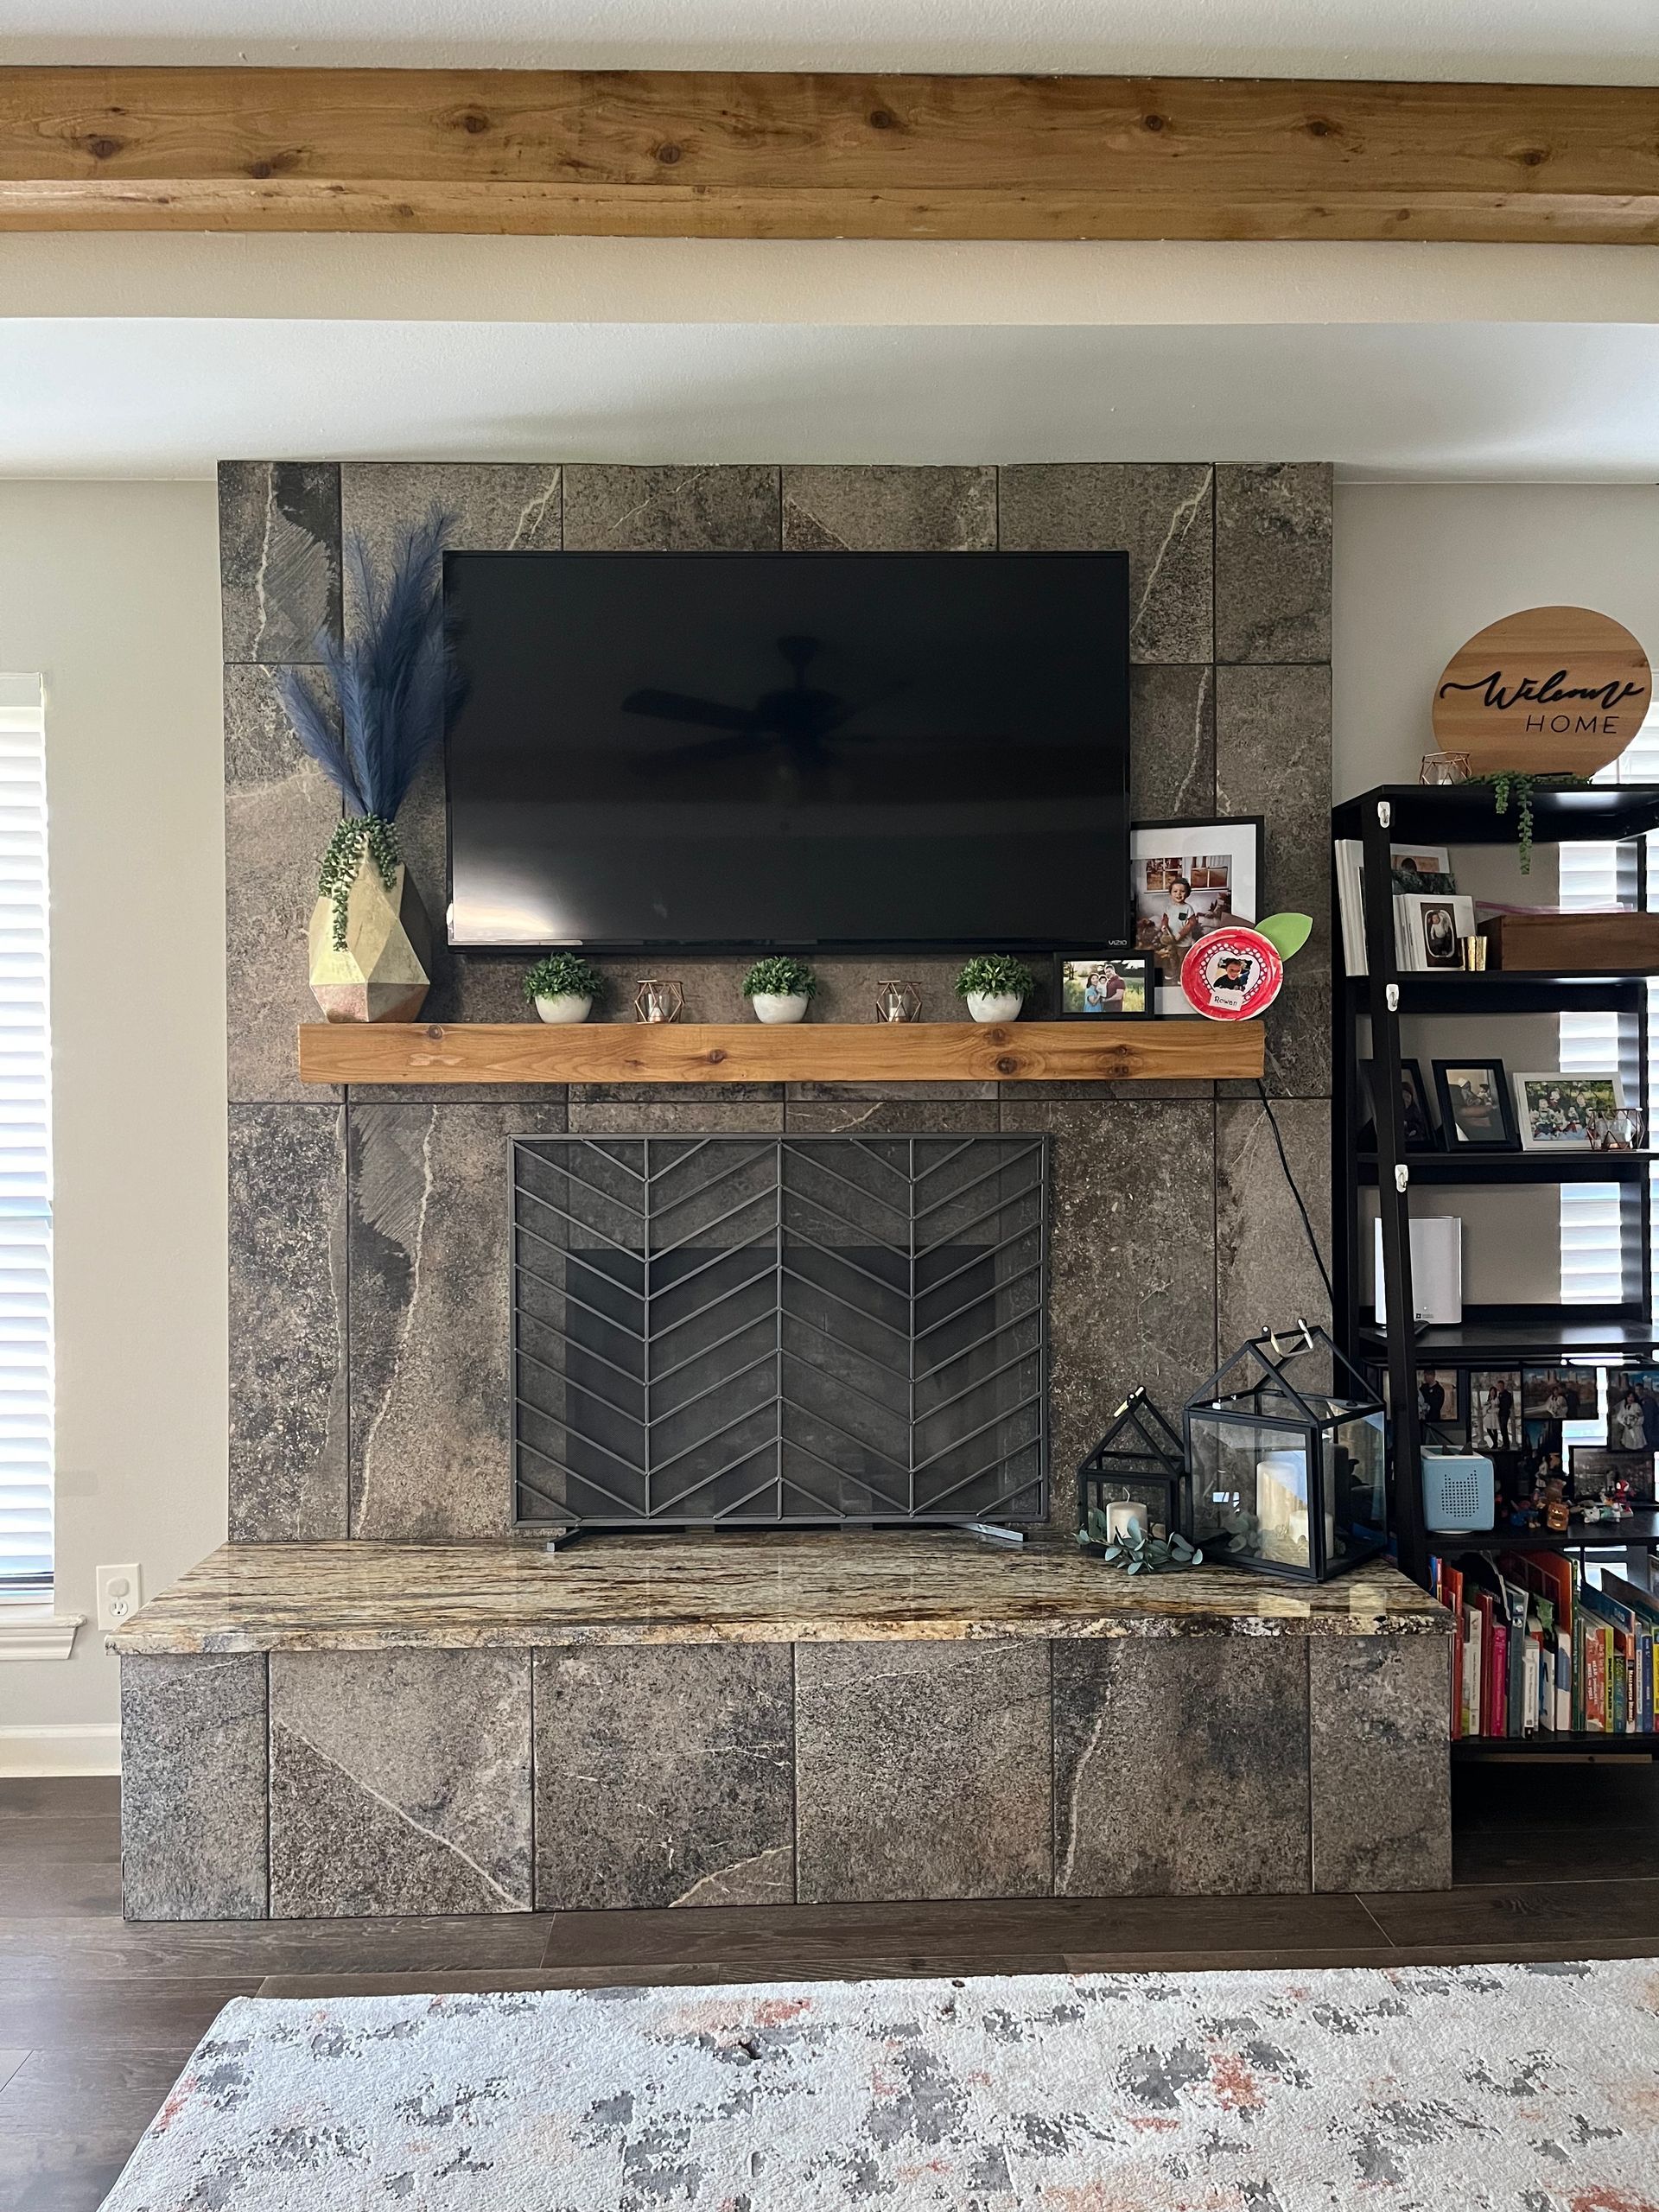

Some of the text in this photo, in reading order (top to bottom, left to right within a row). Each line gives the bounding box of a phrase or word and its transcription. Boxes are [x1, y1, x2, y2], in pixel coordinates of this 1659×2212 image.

[1440, 670, 1644, 709] Welcome
[1526, 715, 1619, 734] HOME
[1214, 995, 1238, 1007] Rowan
